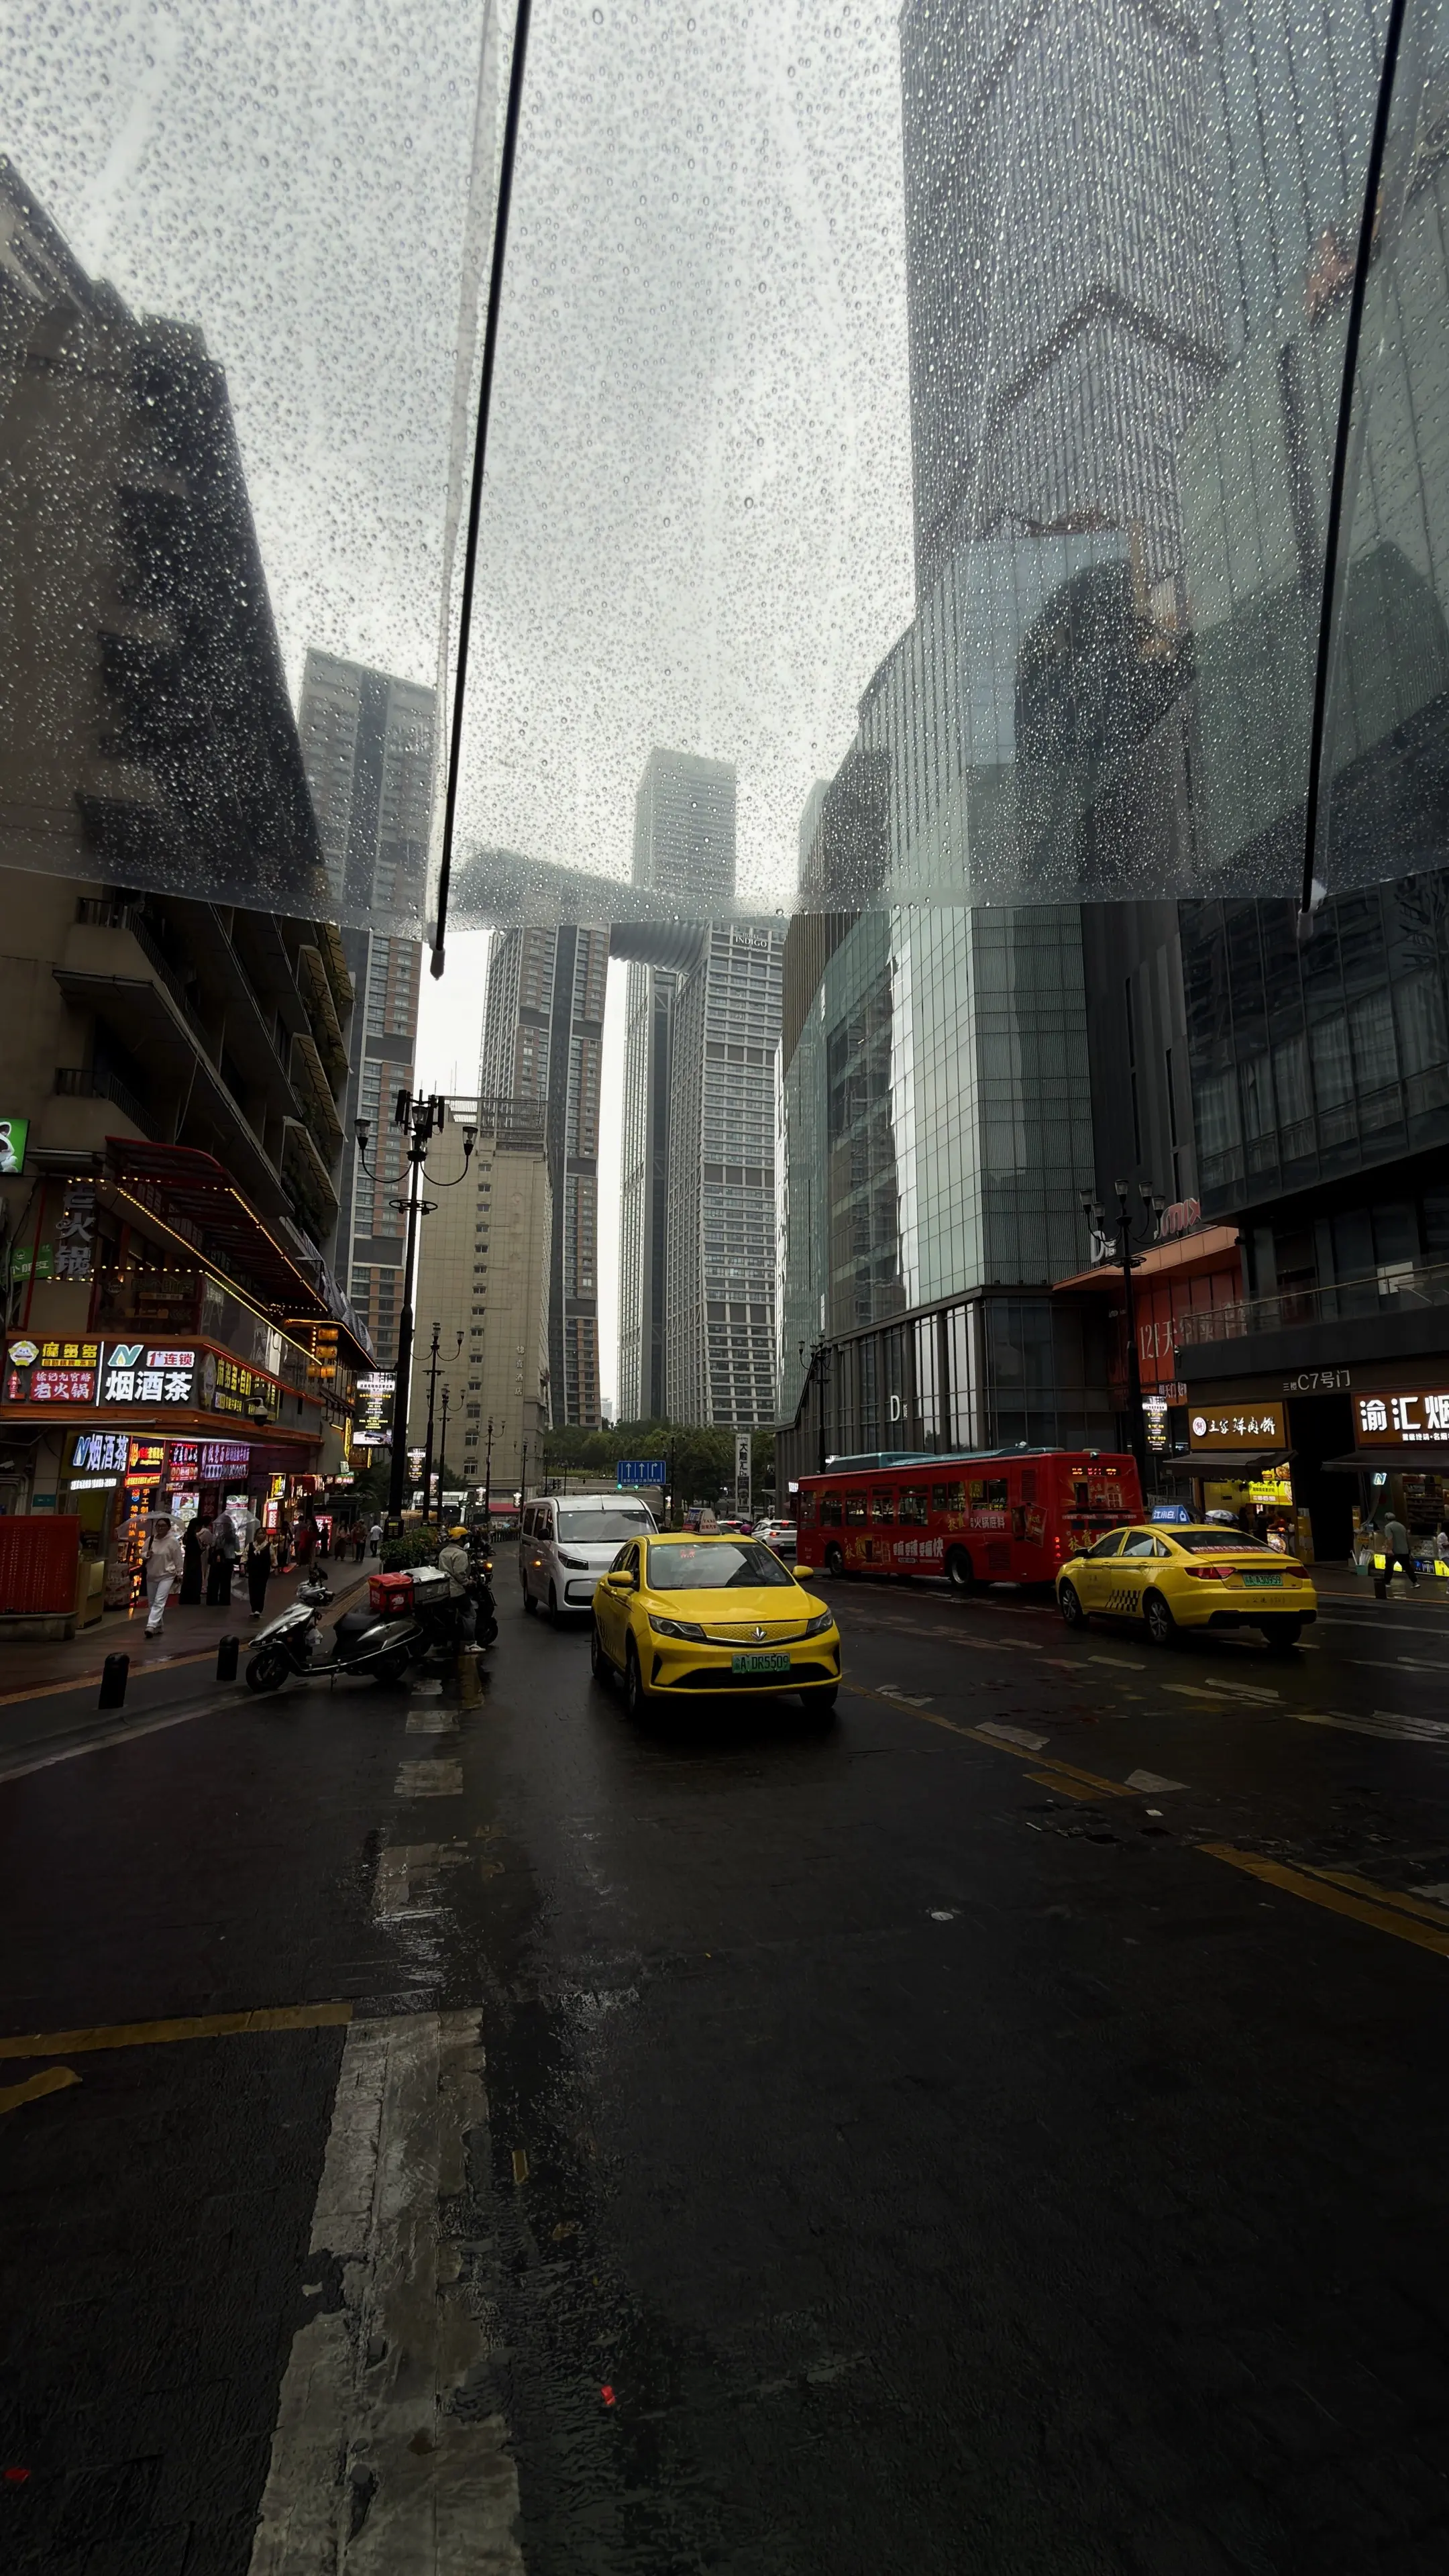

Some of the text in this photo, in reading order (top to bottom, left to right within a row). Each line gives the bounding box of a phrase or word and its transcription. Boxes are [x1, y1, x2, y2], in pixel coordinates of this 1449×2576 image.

[34, 1382, 90, 1399] 老火锅
[105, 1371, 193, 1401] 烟酒茶
[86, 1434, 129, 1471] 烟酒茶
[1153, 1510, 1175, 1519] 江小白
[752, 1656, 789, 1670] DR5509
